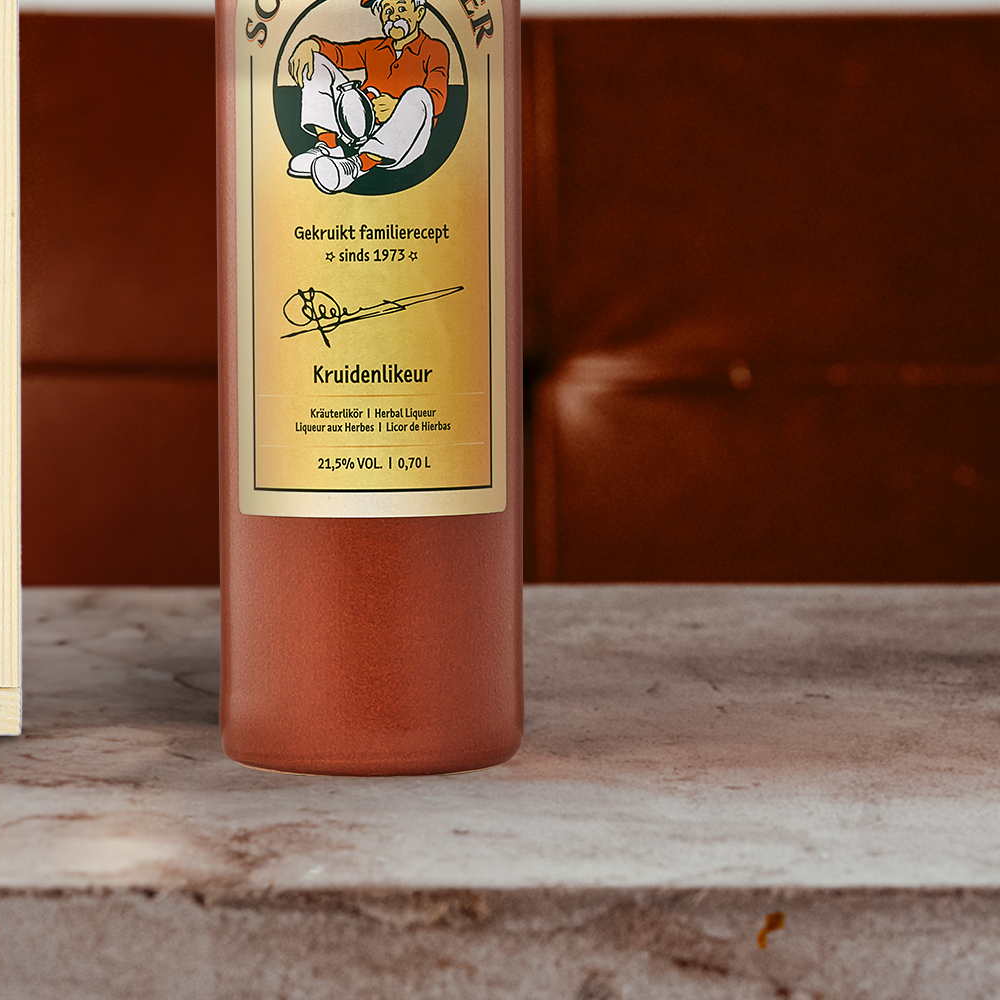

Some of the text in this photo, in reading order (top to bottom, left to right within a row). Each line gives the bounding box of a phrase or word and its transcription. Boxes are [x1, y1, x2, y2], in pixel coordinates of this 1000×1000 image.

[294, 224, 450, 244] Gekruikt familierecept
[338, 248, 406, 262] sinds 1973
[313, 364, 433, 384] Kruidenlikeur
[310, 407, 437, 421] Kräuterlikör Herbal Liqueur
[295, 420, 452, 435] Liqueur aux Herbes Licor de Hierbas
[317, 456, 432, 472] 21,5% VOL. 0,70 L
